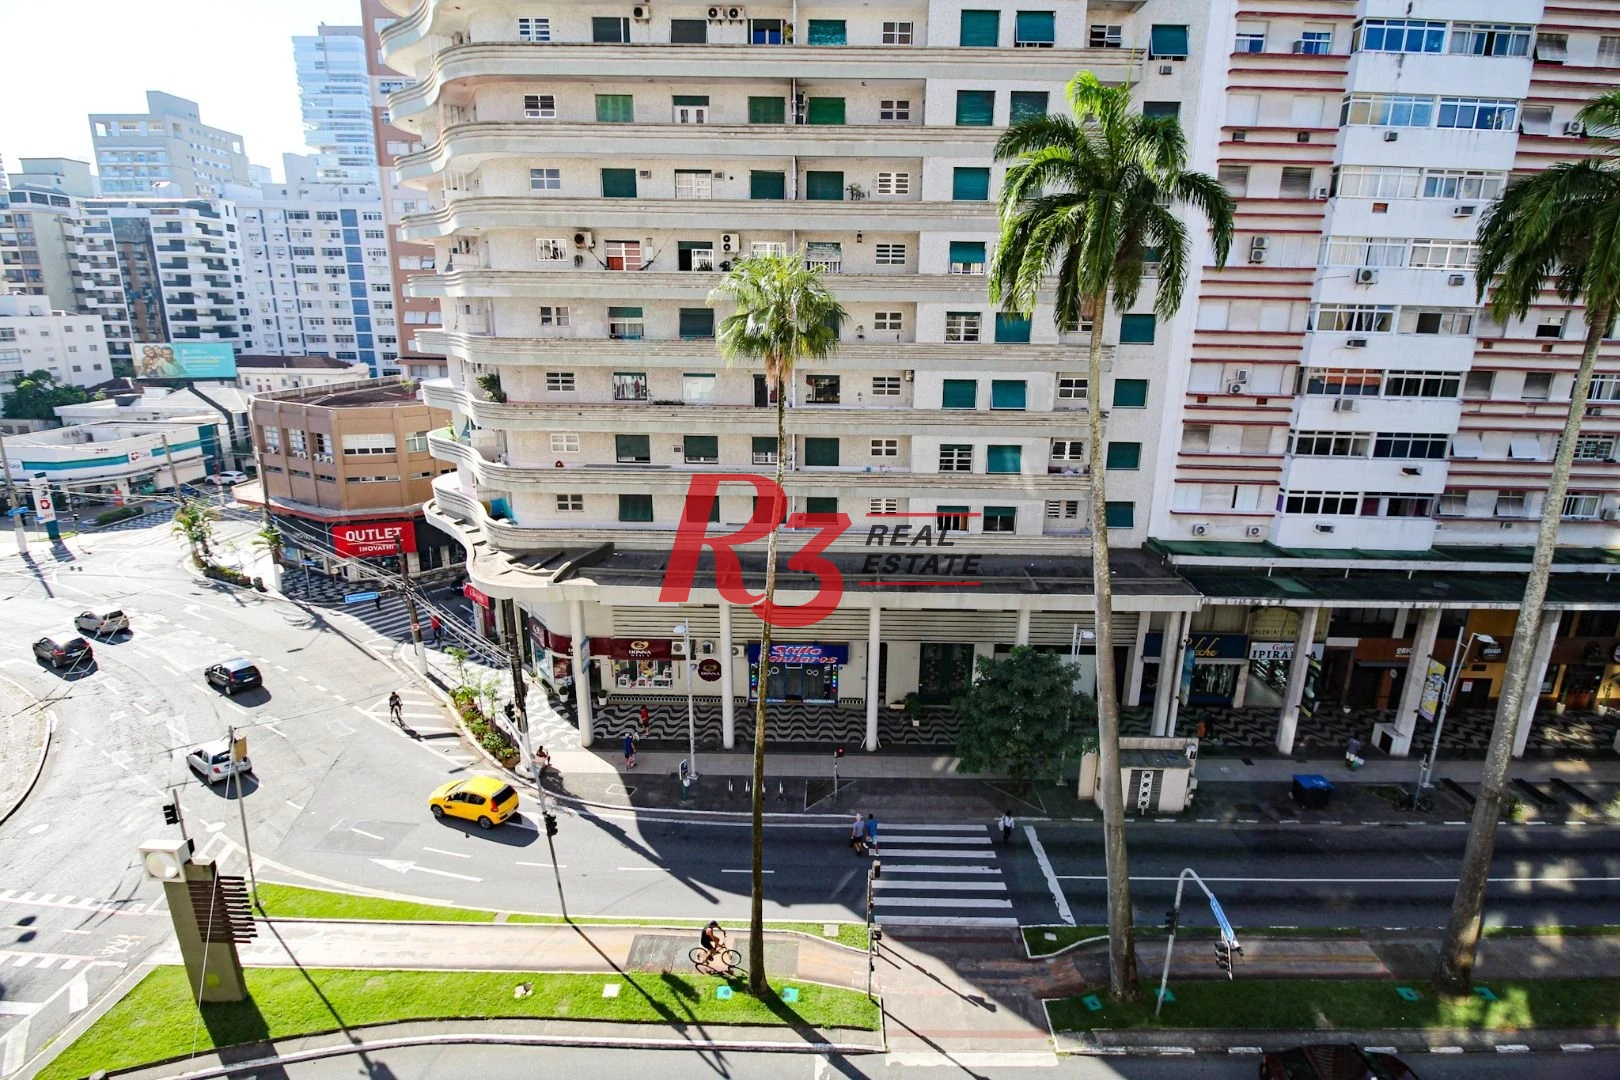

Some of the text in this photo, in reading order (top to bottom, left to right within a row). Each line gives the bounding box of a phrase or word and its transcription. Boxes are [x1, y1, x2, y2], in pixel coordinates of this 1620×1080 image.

[345, 527, 402, 542] OUTLET
[771, 645, 823, 655] Stillo
[1252, 650, 1317, 659] IPIRAA
